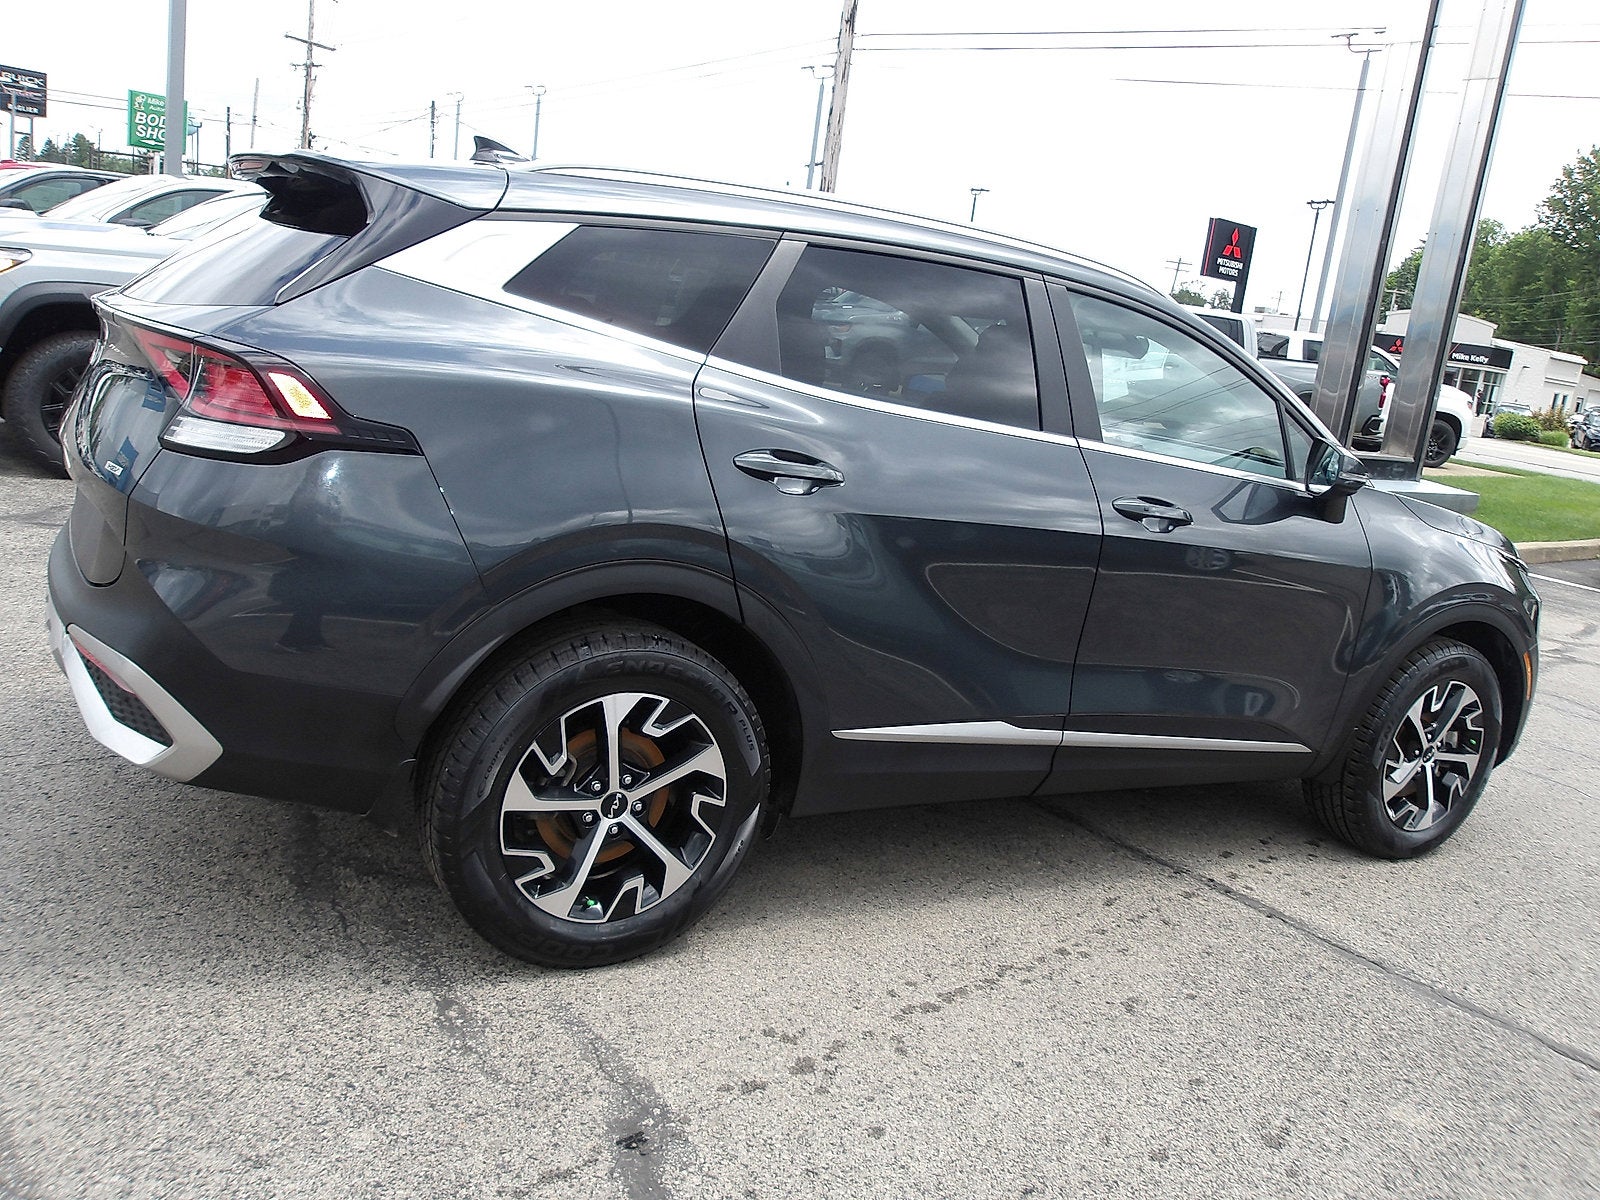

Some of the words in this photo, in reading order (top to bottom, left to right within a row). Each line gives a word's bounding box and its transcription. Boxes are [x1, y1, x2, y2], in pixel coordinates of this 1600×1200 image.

[135, 111, 166, 128] BOD
[135, 125, 165, 140] SHO
[1216, 257, 1244, 270] MITSUBISHI
[1218, 266, 1239, 277] MOTORS
[1451, 352, 1470, 362] Mike
[1470, 354, 1489, 365] Kelly
[737, 718, 757, 752] PLUS
